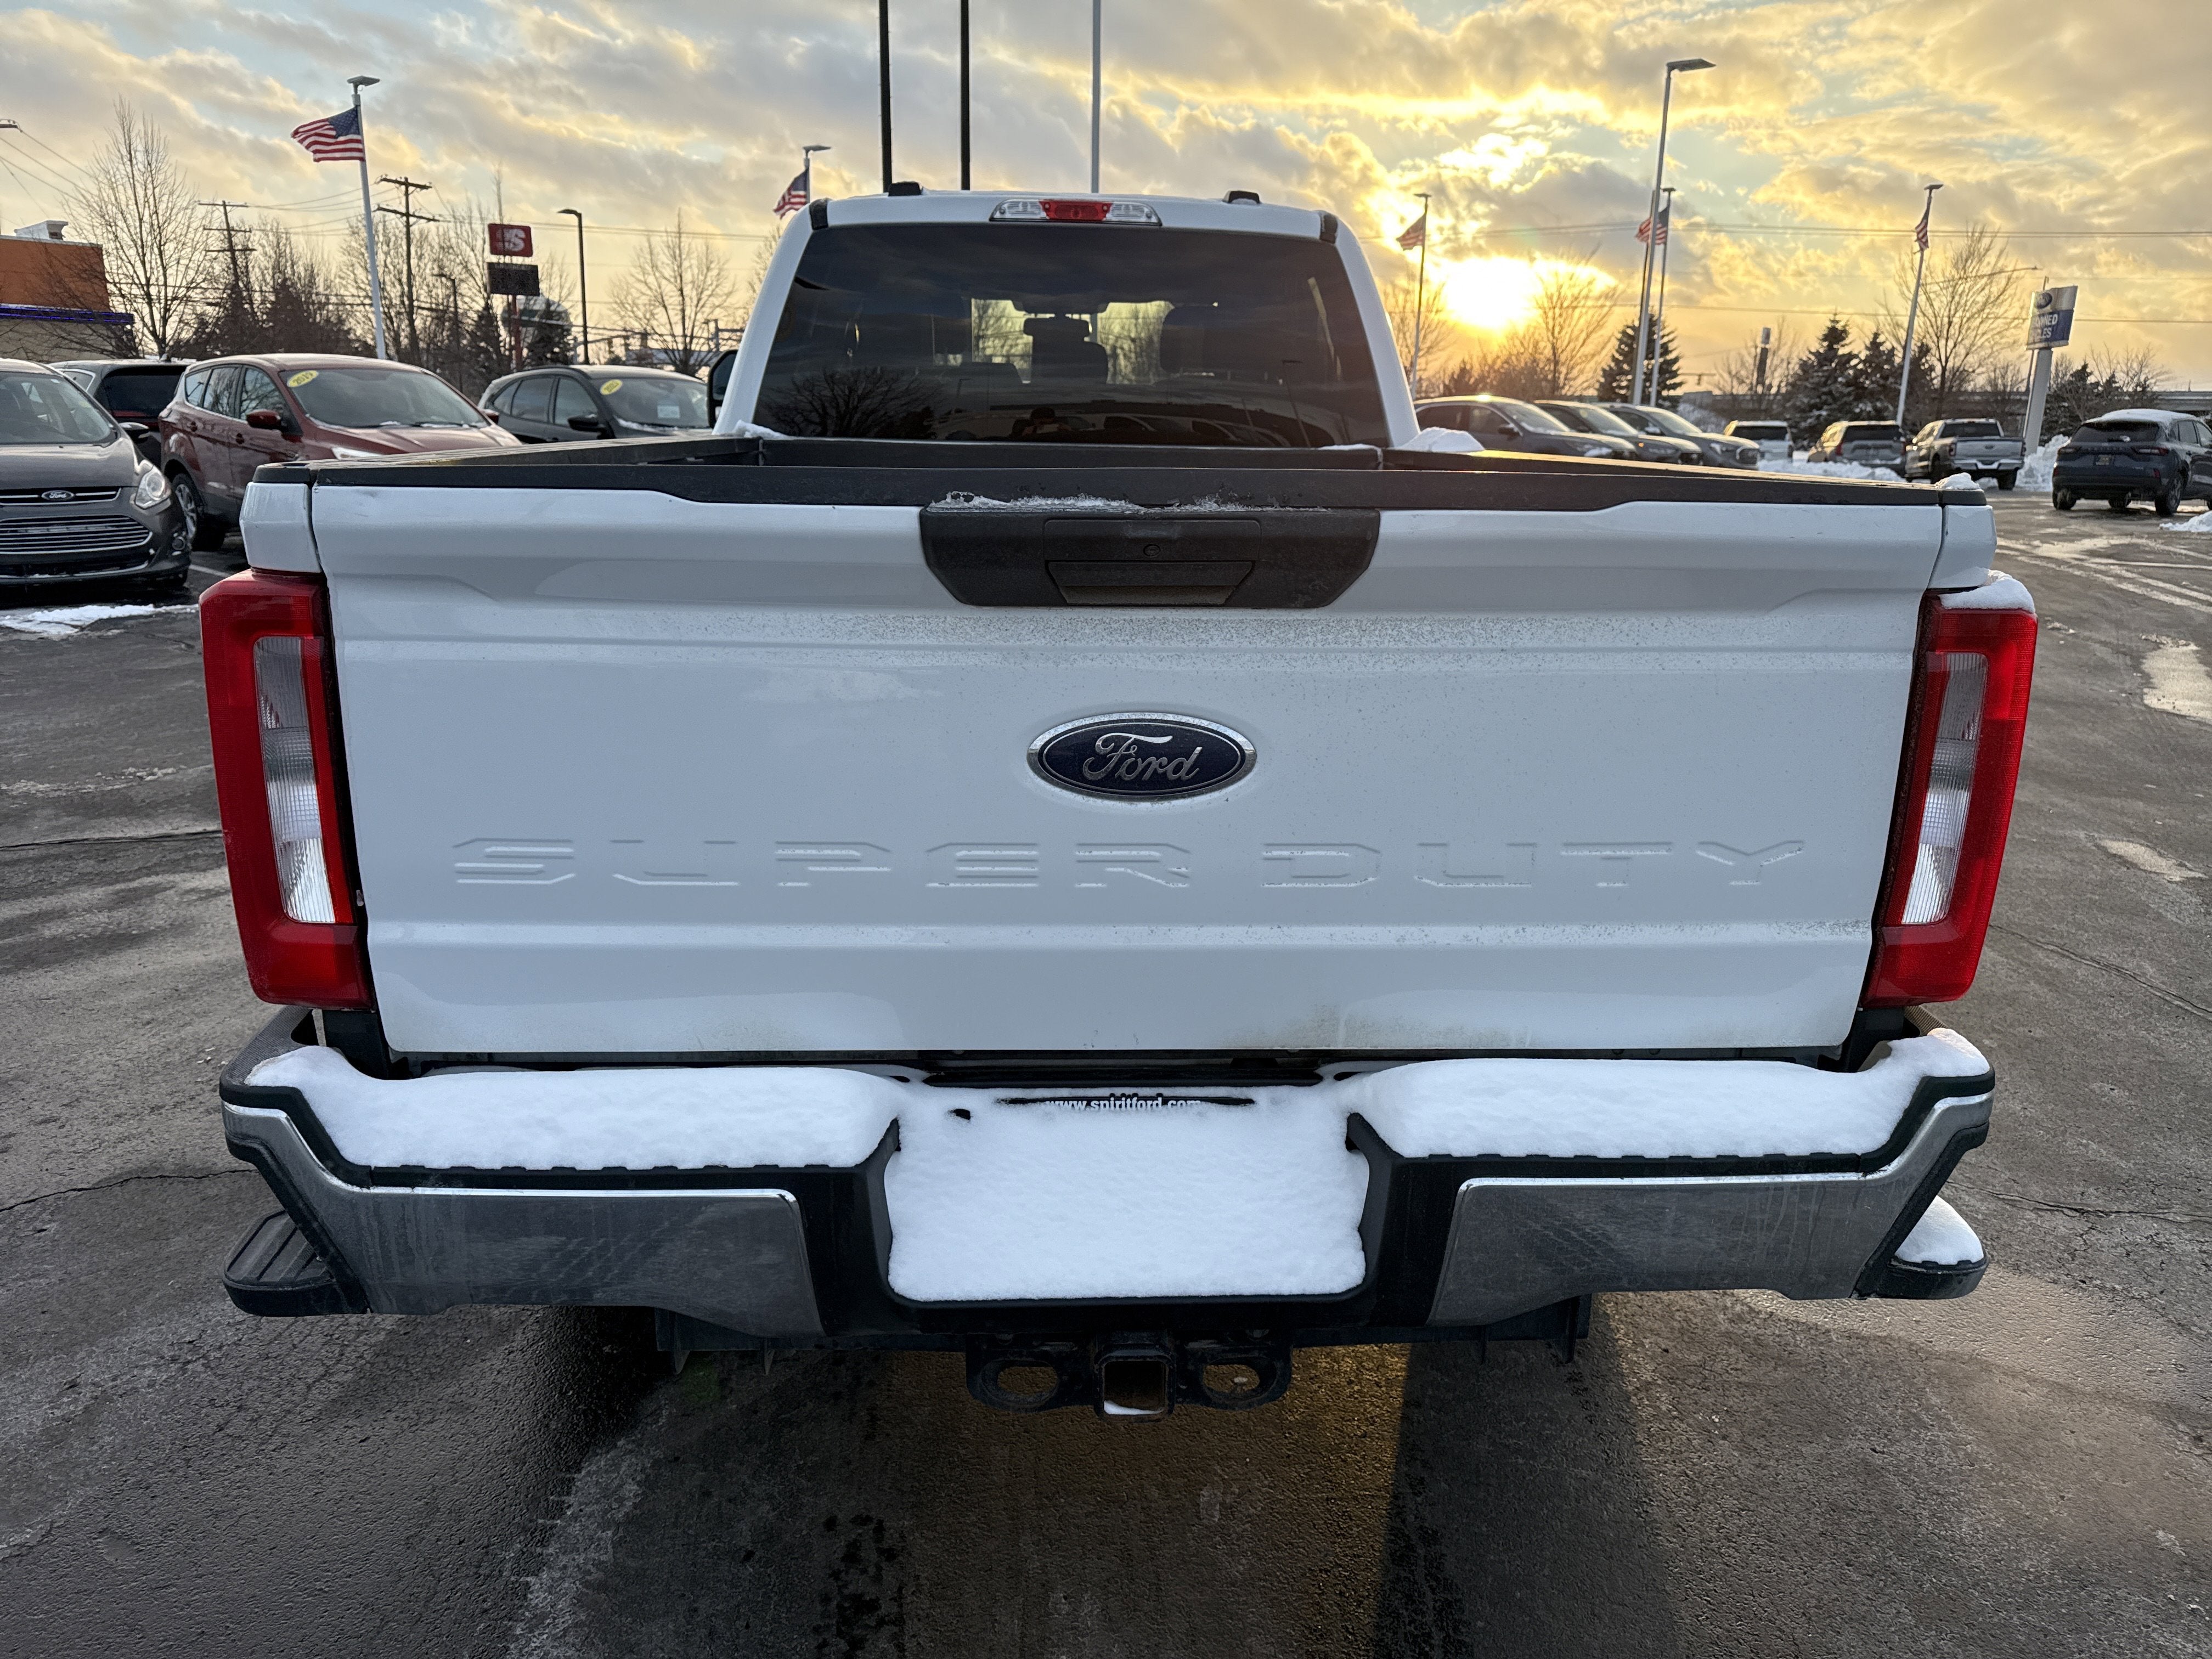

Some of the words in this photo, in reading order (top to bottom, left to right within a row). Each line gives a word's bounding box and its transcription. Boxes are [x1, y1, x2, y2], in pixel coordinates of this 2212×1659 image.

[1082, 732, 1203, 781] Ford
[452, 837, 1190, 888] SUPER
[1261, 840, 1804, 888] DUTY
[1045, 1097, 1203, 1111] ww.spiritfordco
